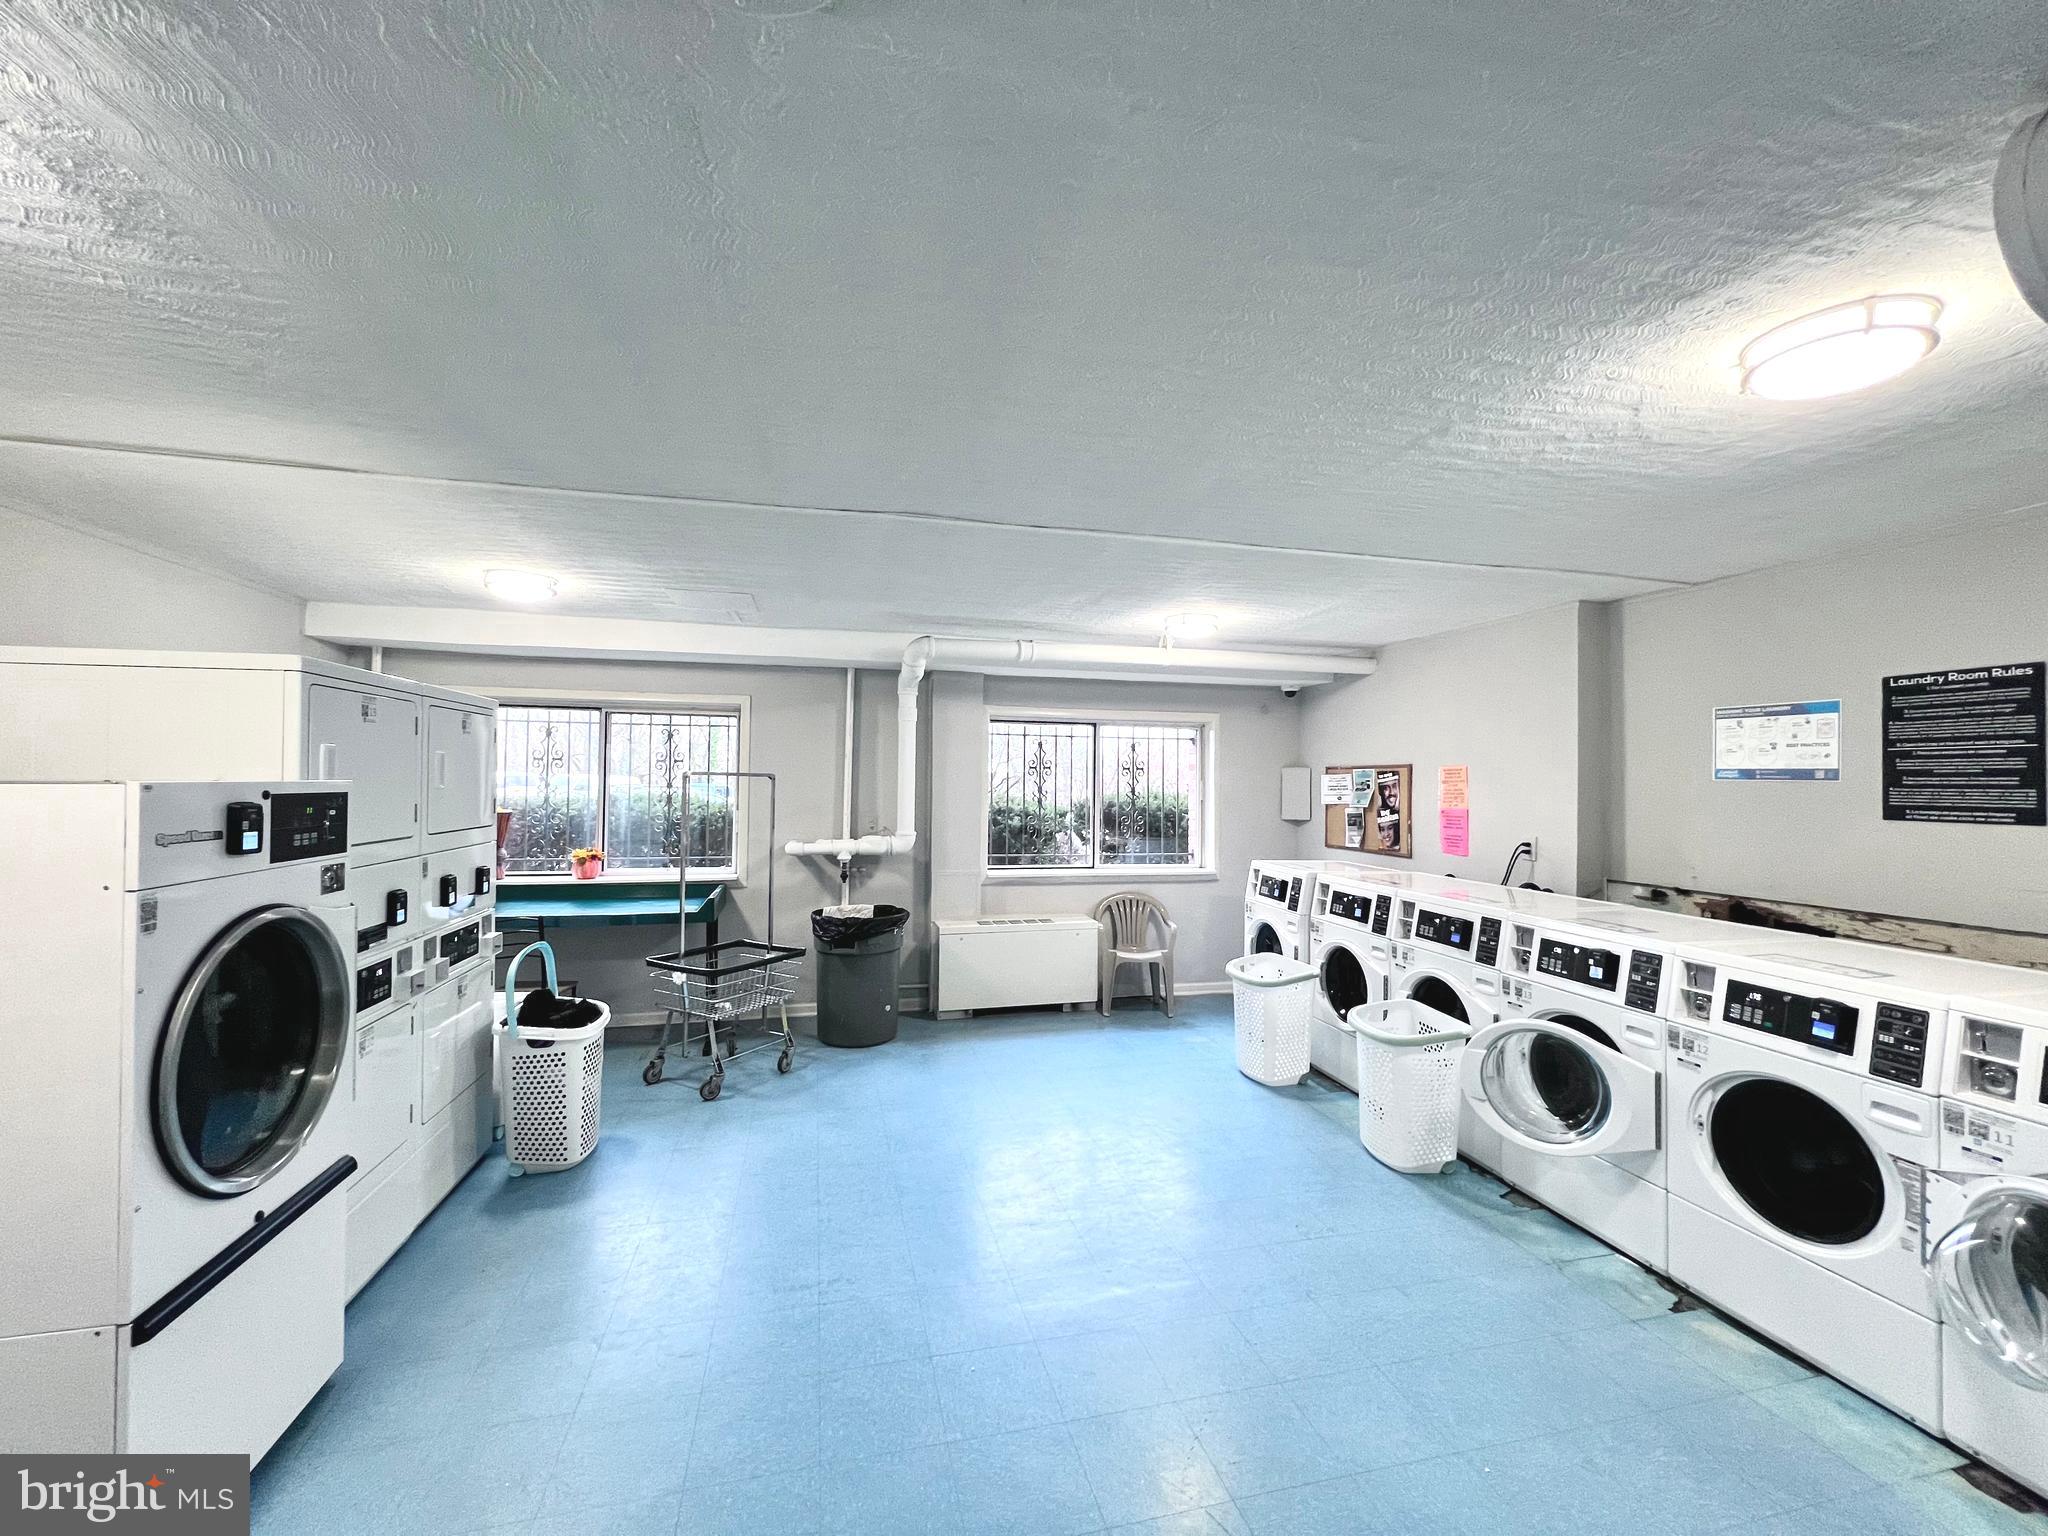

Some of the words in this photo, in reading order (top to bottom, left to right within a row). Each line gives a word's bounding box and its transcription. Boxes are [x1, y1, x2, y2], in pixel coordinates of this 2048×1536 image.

[1889, 674, 1945, 687] Laundry
[1947, 671, 1988, 681] Room
[1991, 666, 2034, 677] Rules
[1697, 1043, 1709, 1056] 12
[1994, 1130, 2015, 1147] 11
